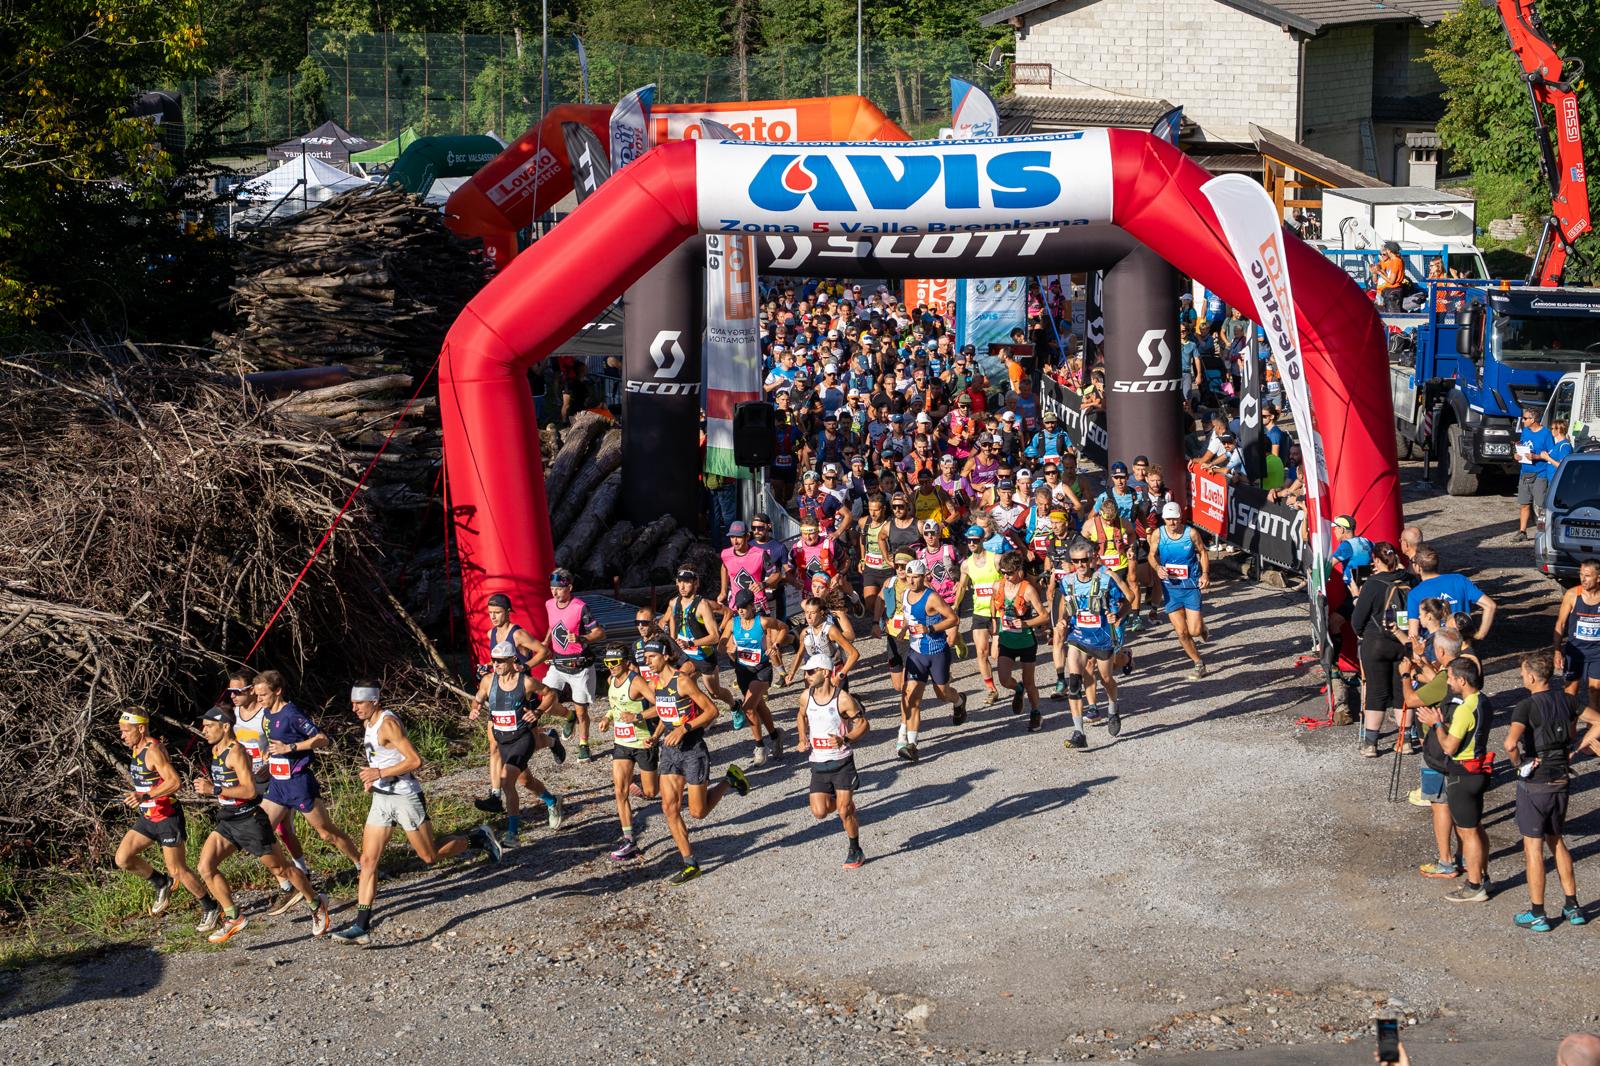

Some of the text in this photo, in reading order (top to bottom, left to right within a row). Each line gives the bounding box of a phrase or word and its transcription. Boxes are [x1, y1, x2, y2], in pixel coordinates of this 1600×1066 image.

[656, 117, 791, 142] Loato
[1565, 100, 1578, 139] FASSI
[1013, 133, 1075, 142] SANGUE
[749, 151, 1061, 212] AVIS
[719, 218, 1090, 234] Zona 5 Valle Brembana
[817, 227, 1061, 259] SCOTT
[1236, 503, 1291, 542] SCOTT
[1581, 626, 1599, 635] 337
[276, 765, 282, 773] 4
